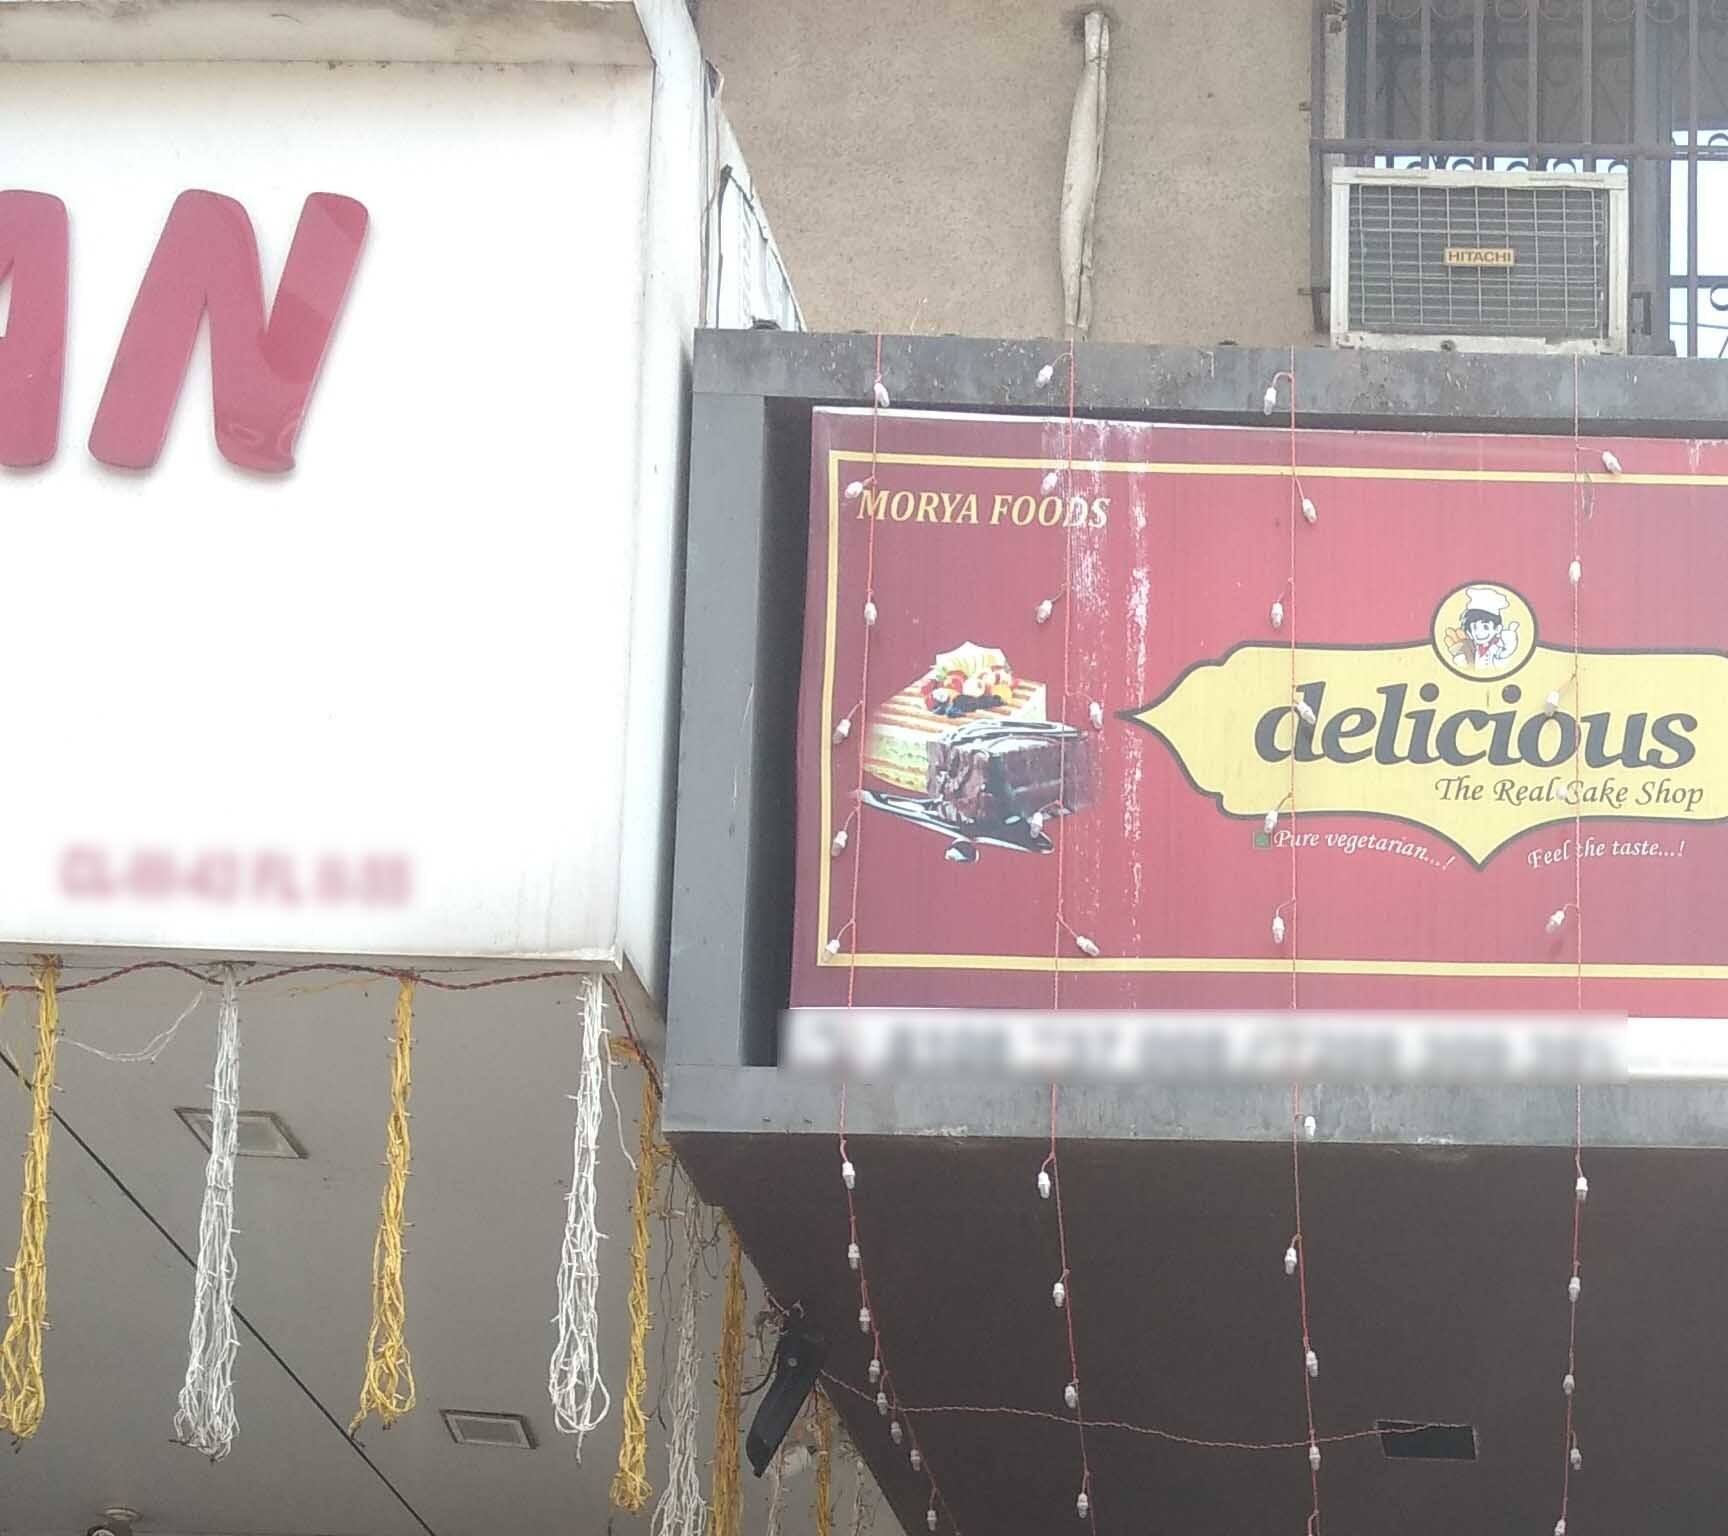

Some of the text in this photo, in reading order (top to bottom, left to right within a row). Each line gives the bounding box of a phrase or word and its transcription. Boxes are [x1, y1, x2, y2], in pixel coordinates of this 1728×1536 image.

[1447, 249, 1513, 265] HITACHI
[856, 488, 1111, 529] MORYA FOODS
[1253, 681, 1698, 769] delicious
[1435, 776, 1486, 803] The
[1493, 776, 1556, 804] Real
[1636, 777, 1705, 812] Shop
[1273, 828, 1321, 850] Pure
[1526, 838, 1571, 870] Feel
[1576, 836, 1613, 860] the
